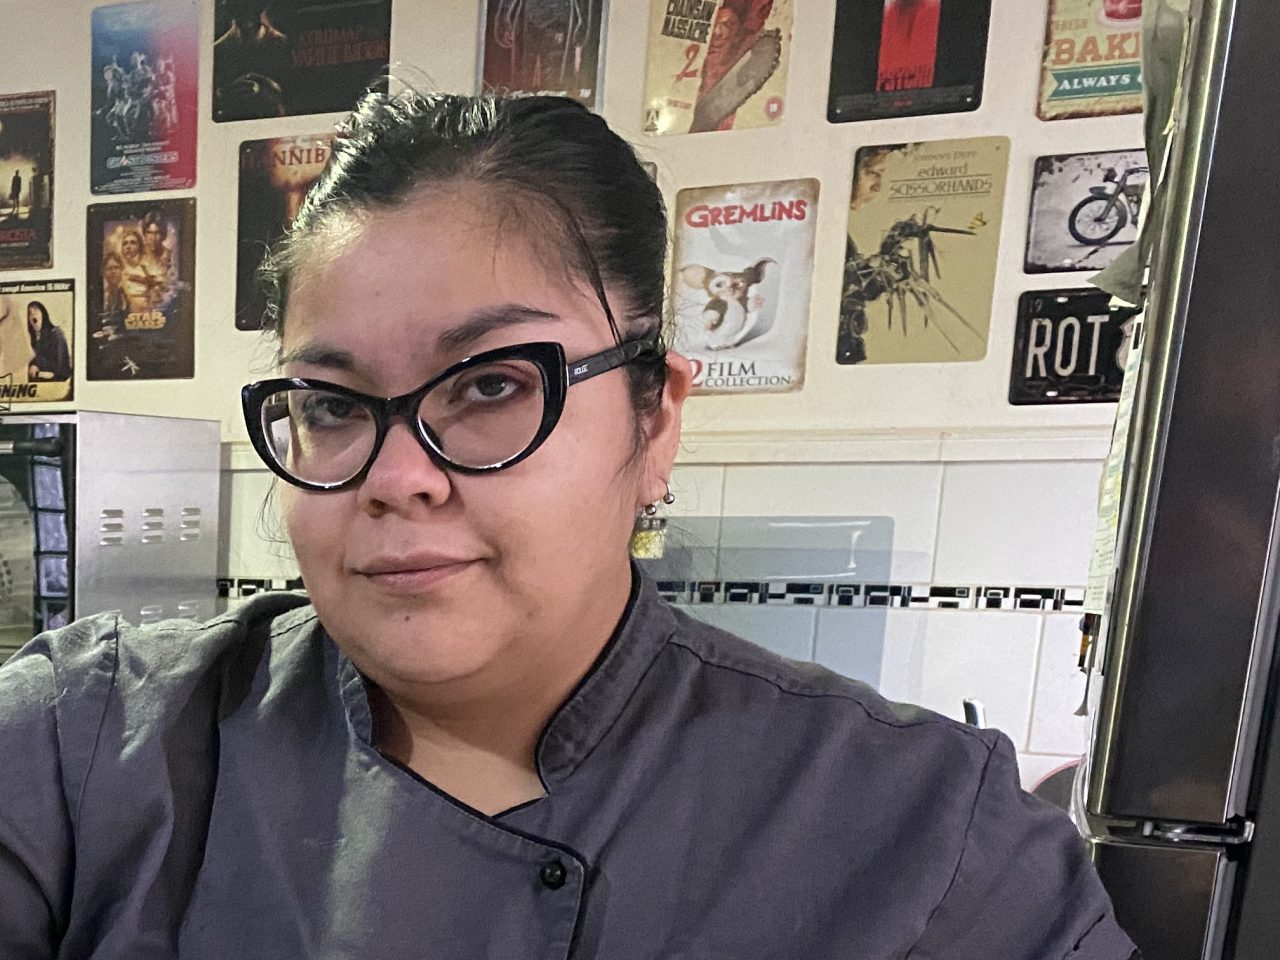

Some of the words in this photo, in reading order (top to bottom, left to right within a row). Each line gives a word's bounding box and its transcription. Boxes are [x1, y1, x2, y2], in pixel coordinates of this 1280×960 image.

[1058, 73, 1131, 90] ALWAYS
[918, 163, 968, 177] edward
[890, 177, 992, 196] SCISSORHANDS
[127, 310, 164, 322] STAR
[124, 320, 165, 330] WARS
[1025, 315, 1110, 377] ROT
[707, 361, 756, 377] FILM
[705, 375, 792, 388] COLLECTION
